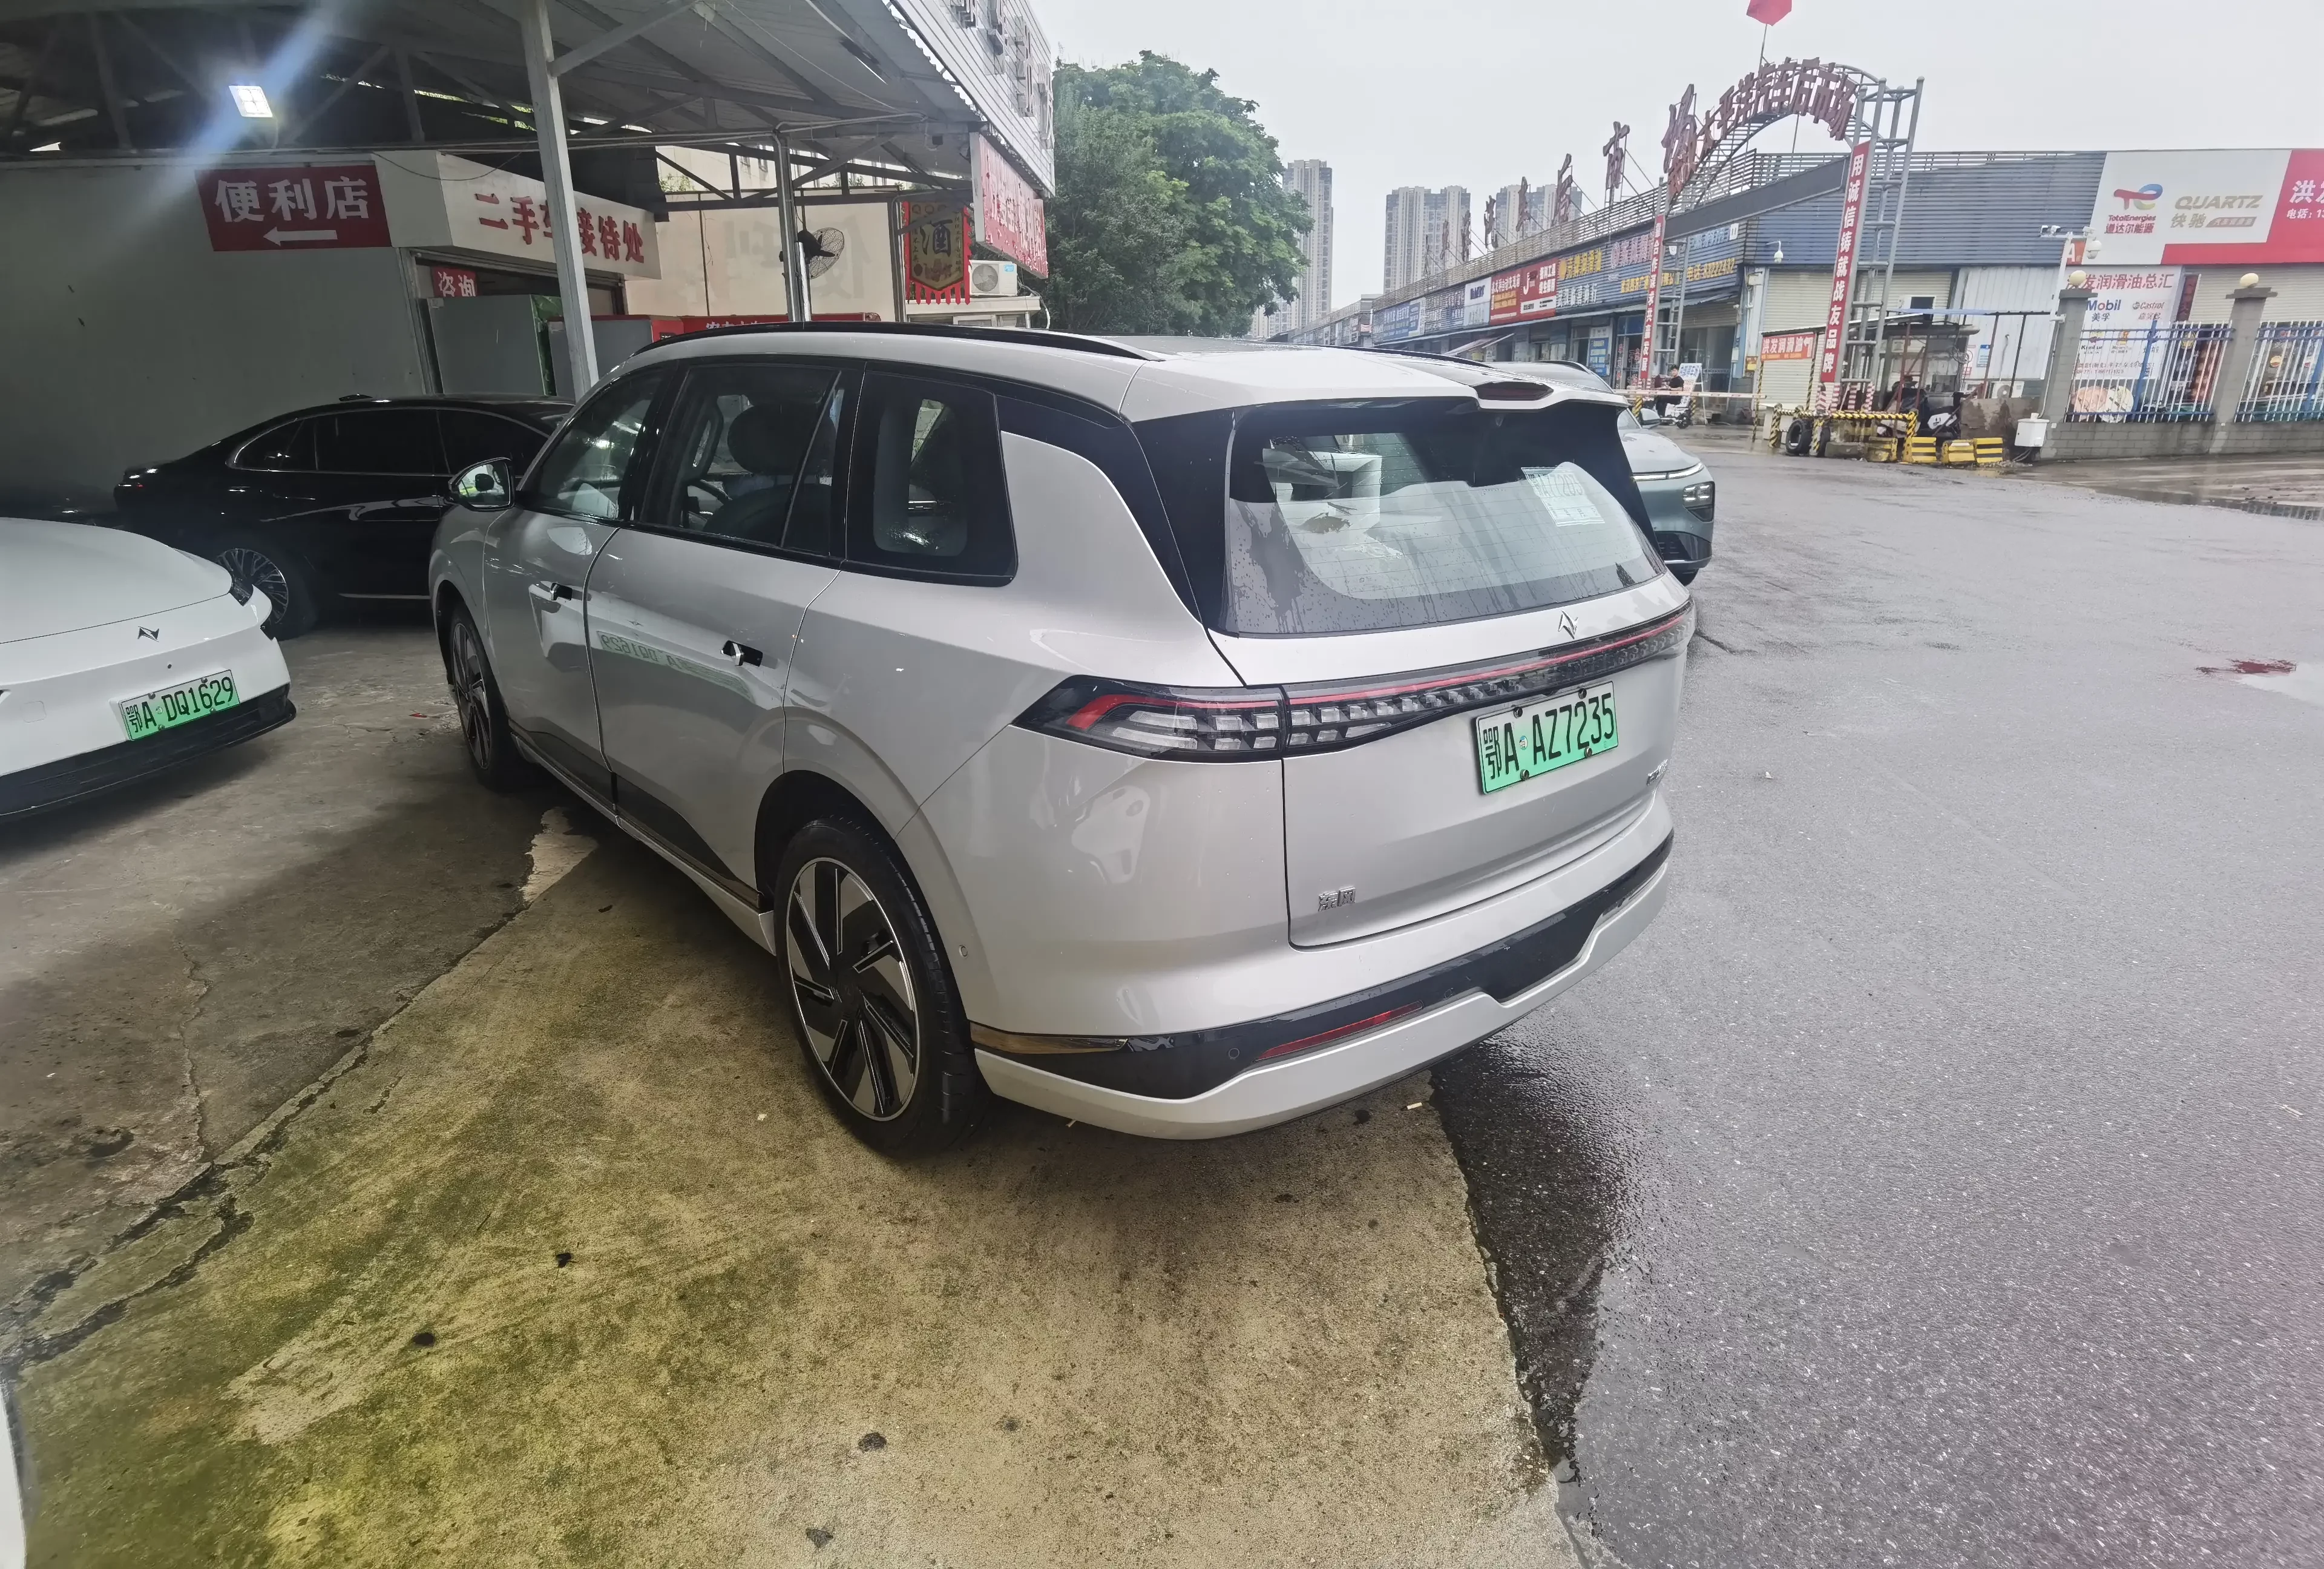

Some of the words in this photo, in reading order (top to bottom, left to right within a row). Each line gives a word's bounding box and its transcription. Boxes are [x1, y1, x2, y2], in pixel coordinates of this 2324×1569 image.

[214, 176, 369, 223] 便利店
[2175, 195, 2263, 209] QUARTZ
[2104, 223, 2155, 234] 道达尔能源
[919, 219, 953, 258] 酒
[1822, 154, 1864, 373] 用诚信铸就战友品牌
[438, 271, 477, 297] 咨询
[2067, 274, 2174, 290] 发润滑油总汇
[2087, 299, 2122, 311] Mobil
[2140, 301, 2165, 310] Castrol
[2092, 312, 2110, 321] 美孚
